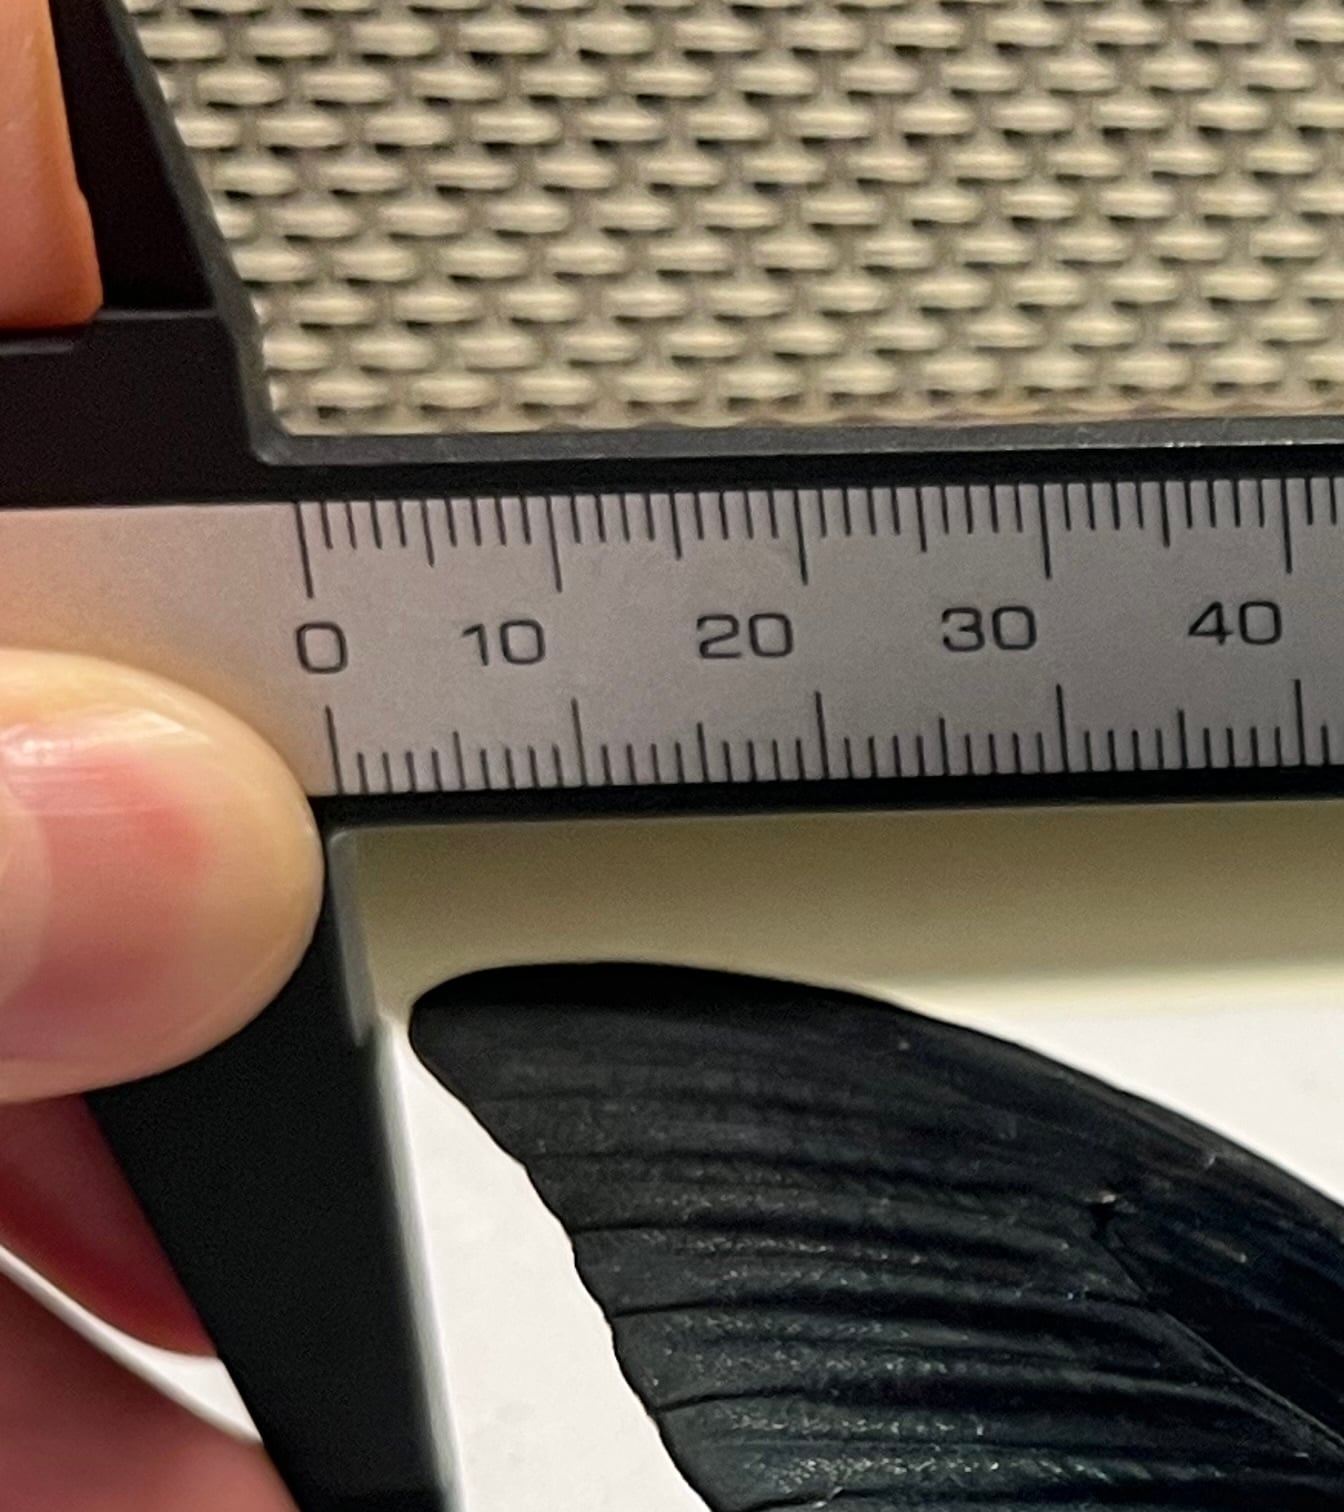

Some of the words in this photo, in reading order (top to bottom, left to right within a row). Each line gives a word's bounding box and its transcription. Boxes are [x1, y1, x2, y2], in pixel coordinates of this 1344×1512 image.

[294, 621, 348, 675] 0
[462, 618, 546, 667] 10
[696, 611, 794, 660] 20
[941, 605, 1037, 653] 30
[1187, 600, 1282, 646] 40
